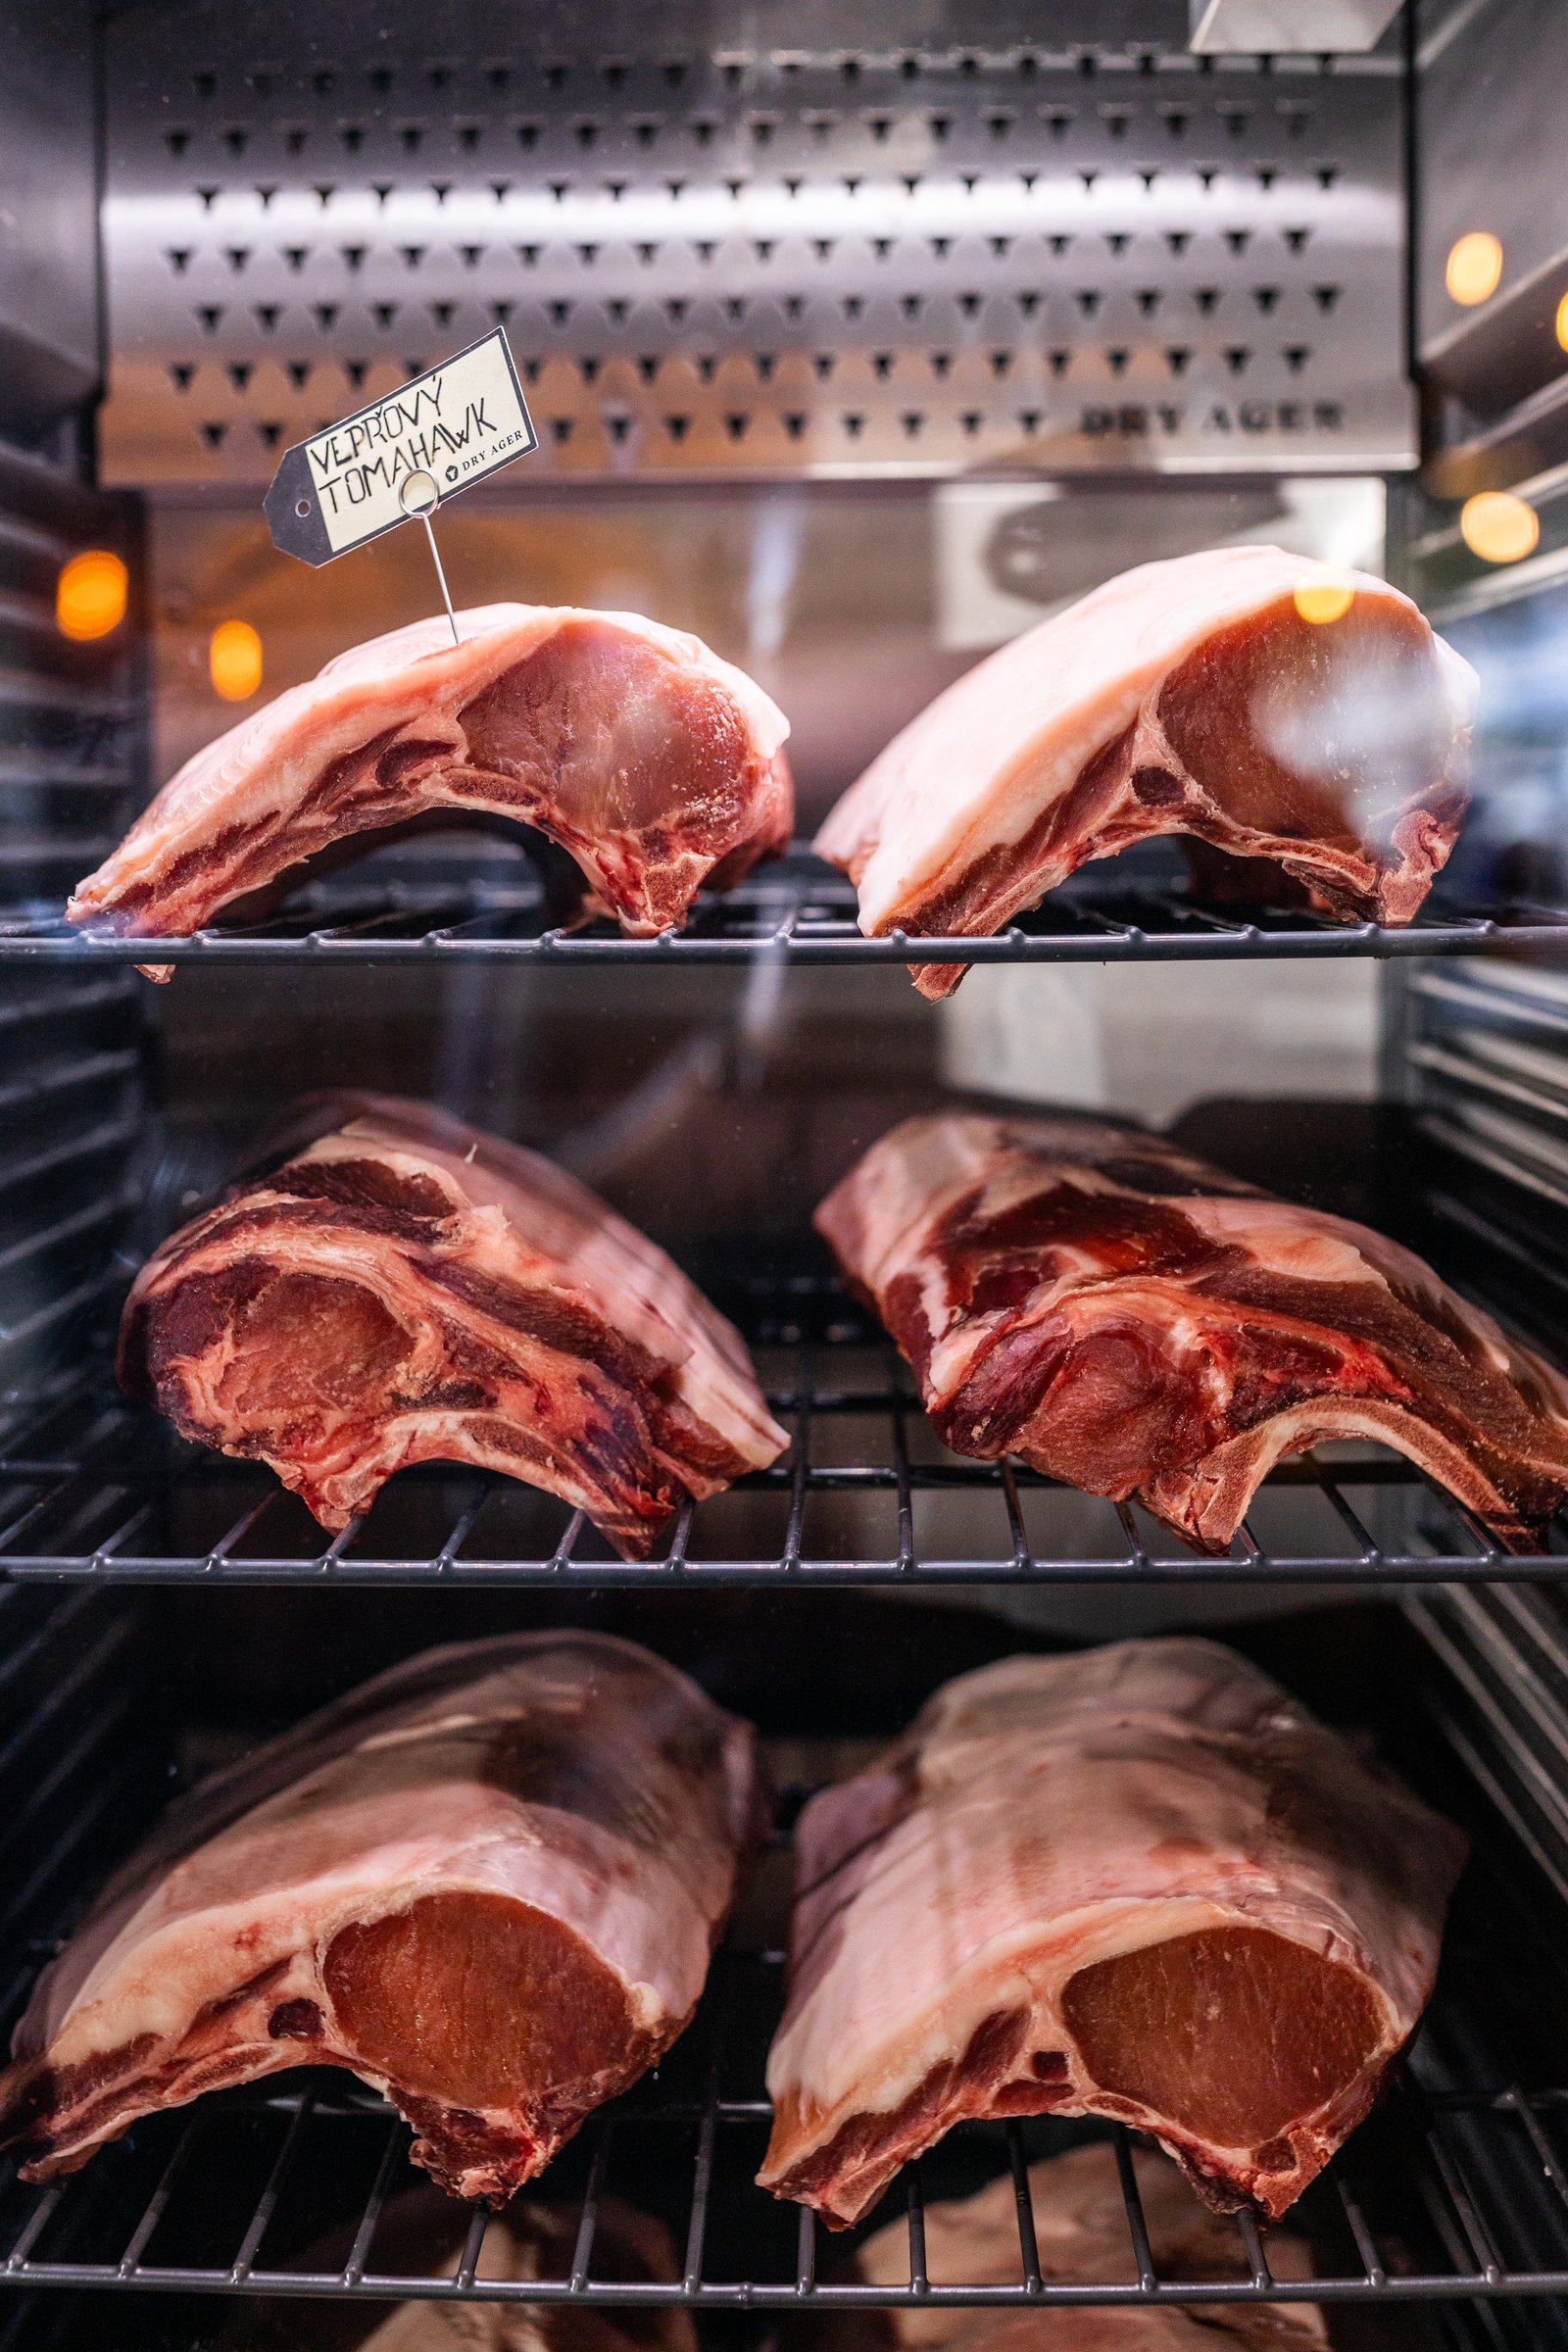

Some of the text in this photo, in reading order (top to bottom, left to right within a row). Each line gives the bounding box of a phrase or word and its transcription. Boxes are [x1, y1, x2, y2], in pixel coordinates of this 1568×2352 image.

[1201, 399, 1344, 434] AGER
[318, 397, 497, 514] TOMAHAWK
[462, 430, 523, 471] DRY AGER
